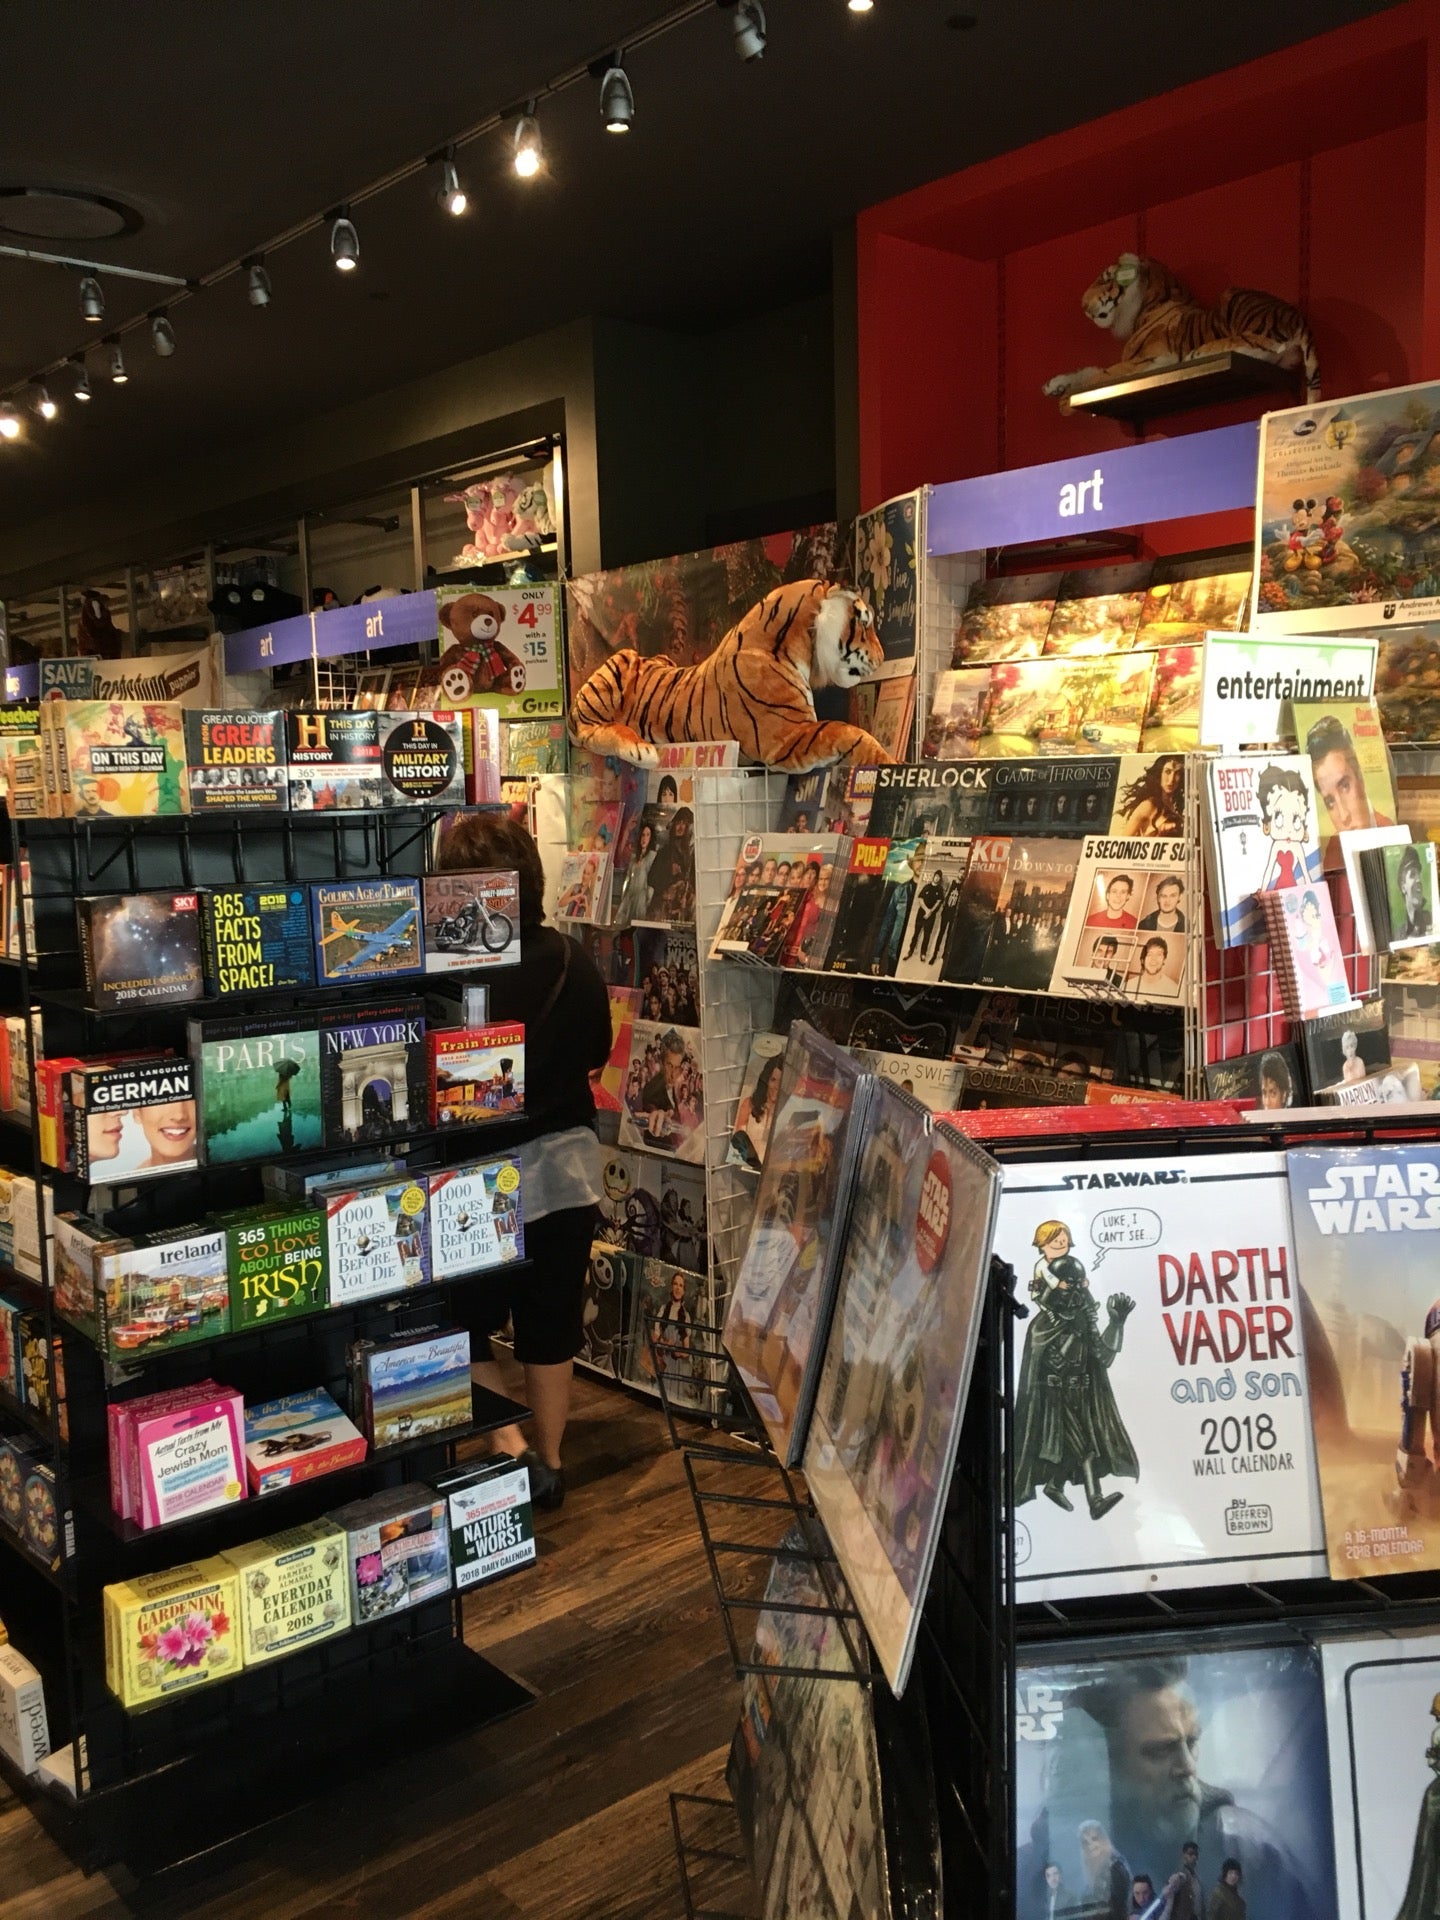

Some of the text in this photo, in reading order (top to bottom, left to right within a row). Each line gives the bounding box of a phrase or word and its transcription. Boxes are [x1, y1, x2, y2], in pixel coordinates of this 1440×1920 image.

[1059, 470, 1104, 517] art
[521, 591, 545, 600] ONLY
[365, 610, 383, 638] art
[525, 631, 540, 639] with
[260, 632, 274, 656] art
[523, 641, 547, 656] $15
[44, 664, 86, 684] SAVE
[1217, 669, 1365, 699] entertainment
[523, 698, 560, 714] Gus
[202, 714, 274, 725] GREAT QUOTES
[329, 719, 375, 729] THIS DAY
[211, 724, 274, 747] GREAT
[329, 732, 376, 742] IN HISTORY
[92, 752, 164, 766] ON THIS DAY
[203, 746, 276, 765] LEADERS
[292, 752, 333, 761] HISTORY
[392, 753, 449, 765] MILITARY
[298, 768, 315, 778] 365
[392, 765, 450, 779] HISTORY
[879, 767, 991, 789] SHERLOCK
[995, 766, 1112, 785] GAME THRONES
[1217, 767, 1253, 790] BETTY
[206, 794, 277, 803] SHAPED THE WORLD
[1223, 791, 1253, 813] BOOP
[854, 843, 887, 867] PULP
[1085, 841, 1167, 861] 5 SECONDS OF
[175, 897, 195, 907] SKY
[260, 895, 287, 906] 2018
[319, 883, 415, 904] GOLDEN AGE FLIGHT
[213, 893, 244, 918] 365
[215, 917, 262, 942] FACTS
[217, 942, 262, 968] FROM
[832, 961, 846, 970] 2018
[104, 975, 158, 991] INCREDIBLE
[219, 964, 274, 993] SPACE!
[115, 984, 188, 1000] 2018 CALENDAR
[379, 1007, 404, 1016] calendar
[1033, 1000, 1080, 1022] THIS
[326, 1021, 421, 1055] NEW YORK
[440, 1033, 522, 1052] Train Trivia
[216, 1037, 306, 1073] PARIS
[103, 1065, 191, 1082] LIVING LANGUAGE
[862, 1059, 963, 1084] AYLOR SWIFT
[93, 1076, 189, 1104] GERMAN
[969, 1070, 1077, 1099] OUTLANDER
[106, 1104, 121, 1112] Daily
[148, 1097, 168, 1105] Culture
[169, 1094, 193, 1102] Calendar
[74, 1110, 84, 1178] GERMAN
[1308, 1162, 1440, 1200] STAR
[437, 1183, 471, 1205] 1,000
[336, 1205, 373, 1227] 1,000
[238, 1217, 320, 1246] 365 THINGS
[160, 1238, 223, 1264] Ireland
[238, 1246, 322, 1275] ABOUT BEING
[1158, 1246, 1291, 1307] DARTH
[1162, 1305, 1296, 1366] VADER
[375, 1339, 467, 1374] America Beautiful
[1171, 1368, 1302, 1404] and son
[262, 1403, 279, 1414] the
[194, 1427, 210, 1439] from
[210, 1420, 223, 1432] My
[1200, 1413, 1277, 1456] 2018
[175, 1440, 208, 1458] Crazy
[158, 1457, 197, 1478] Jewish
[200, 1445, 228, 1461] Mom
[1193, 1453, 1295, 1476] WALL CALENDAR
[184, 1476, 225, 1498] CALENDAR
[465, 1507, 481, 1521] 365
[1229, 1508, 1268, 1521] JEFFREY
[1231, 1499, 1247, 1509] BY
[463, 1509, 512, 1544] NATURE
[1229, 1519, 1269, 1532] BROWN
[1354, 1527, 1408, 1543] 16-MONTH
[475, 1524, 522, 1559] WORST
[1373, 1540, 1424, 1556] CALENDAR
[278, 1564, 313, 1581] FARMER'S
[460, 1547, 533, 1583] 2018 DAILY CALENDAR
[262, 1574, 332, 1610] EVERYDAY
[137, 1590, 225, 1635] GARDENING
[263, 1588, 333, 1624] CALENDAR
[287, 1613, 313, 1632] 2018
